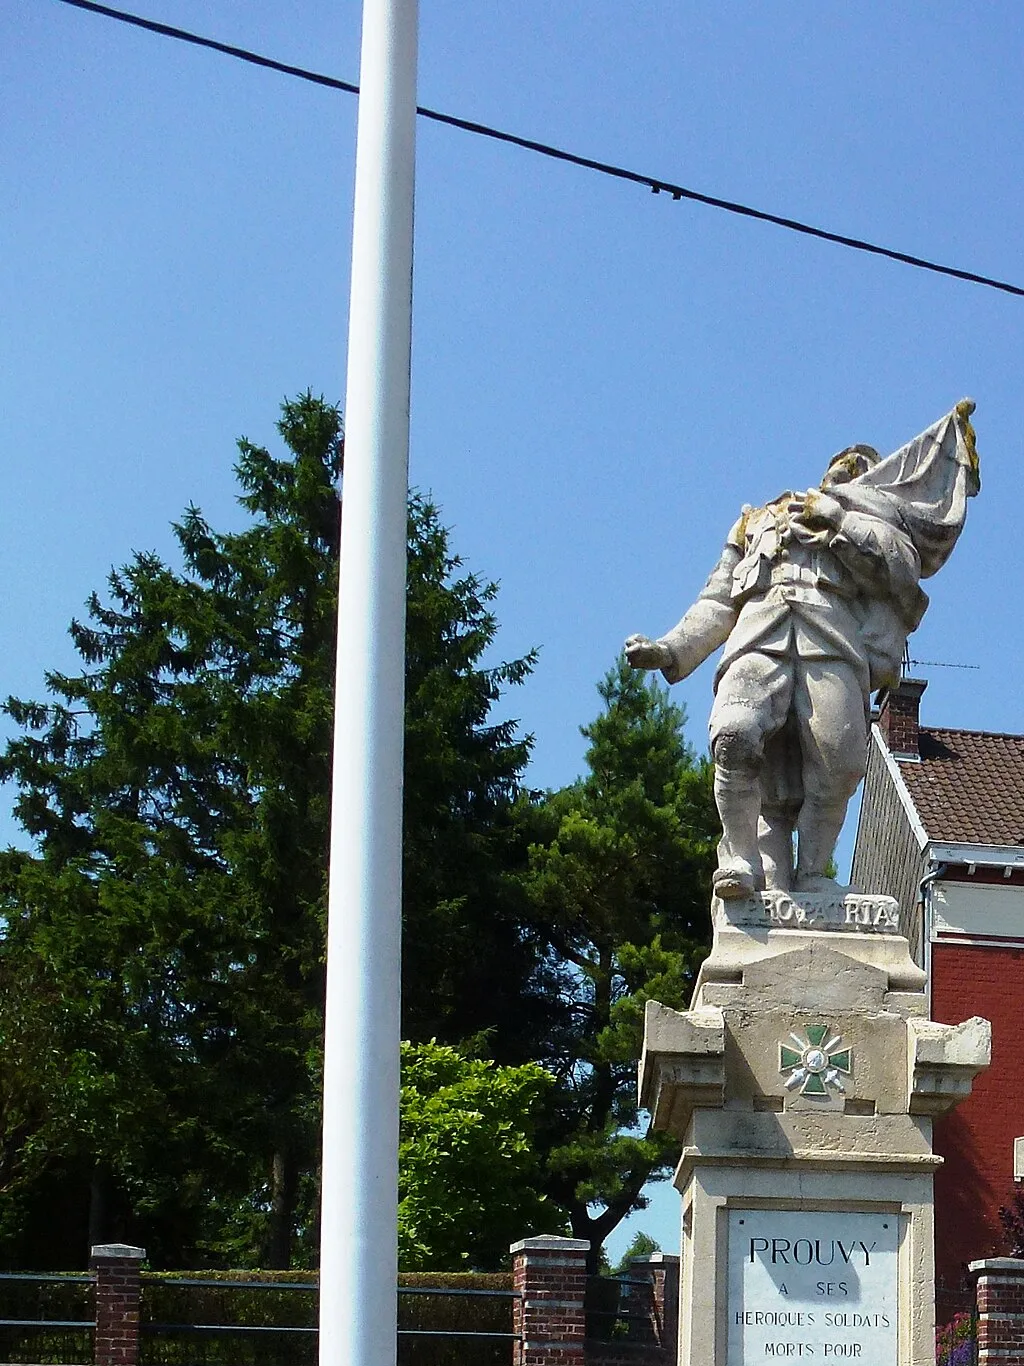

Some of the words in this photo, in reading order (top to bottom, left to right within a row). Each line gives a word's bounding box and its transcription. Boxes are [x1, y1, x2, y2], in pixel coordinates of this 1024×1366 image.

[749, 1237, 877, 1266] PROUVY
[778, 1282, 789, 1295] A
[816, 1282, 848, 1296] SES
[735, 1311, 815, 1327] HEROIQUES
[825, 1313, 890, 1328] SOLDATS
[764, 1342, 814, 1357] MORTS
[824, 1343, 862, 1358] POUR
